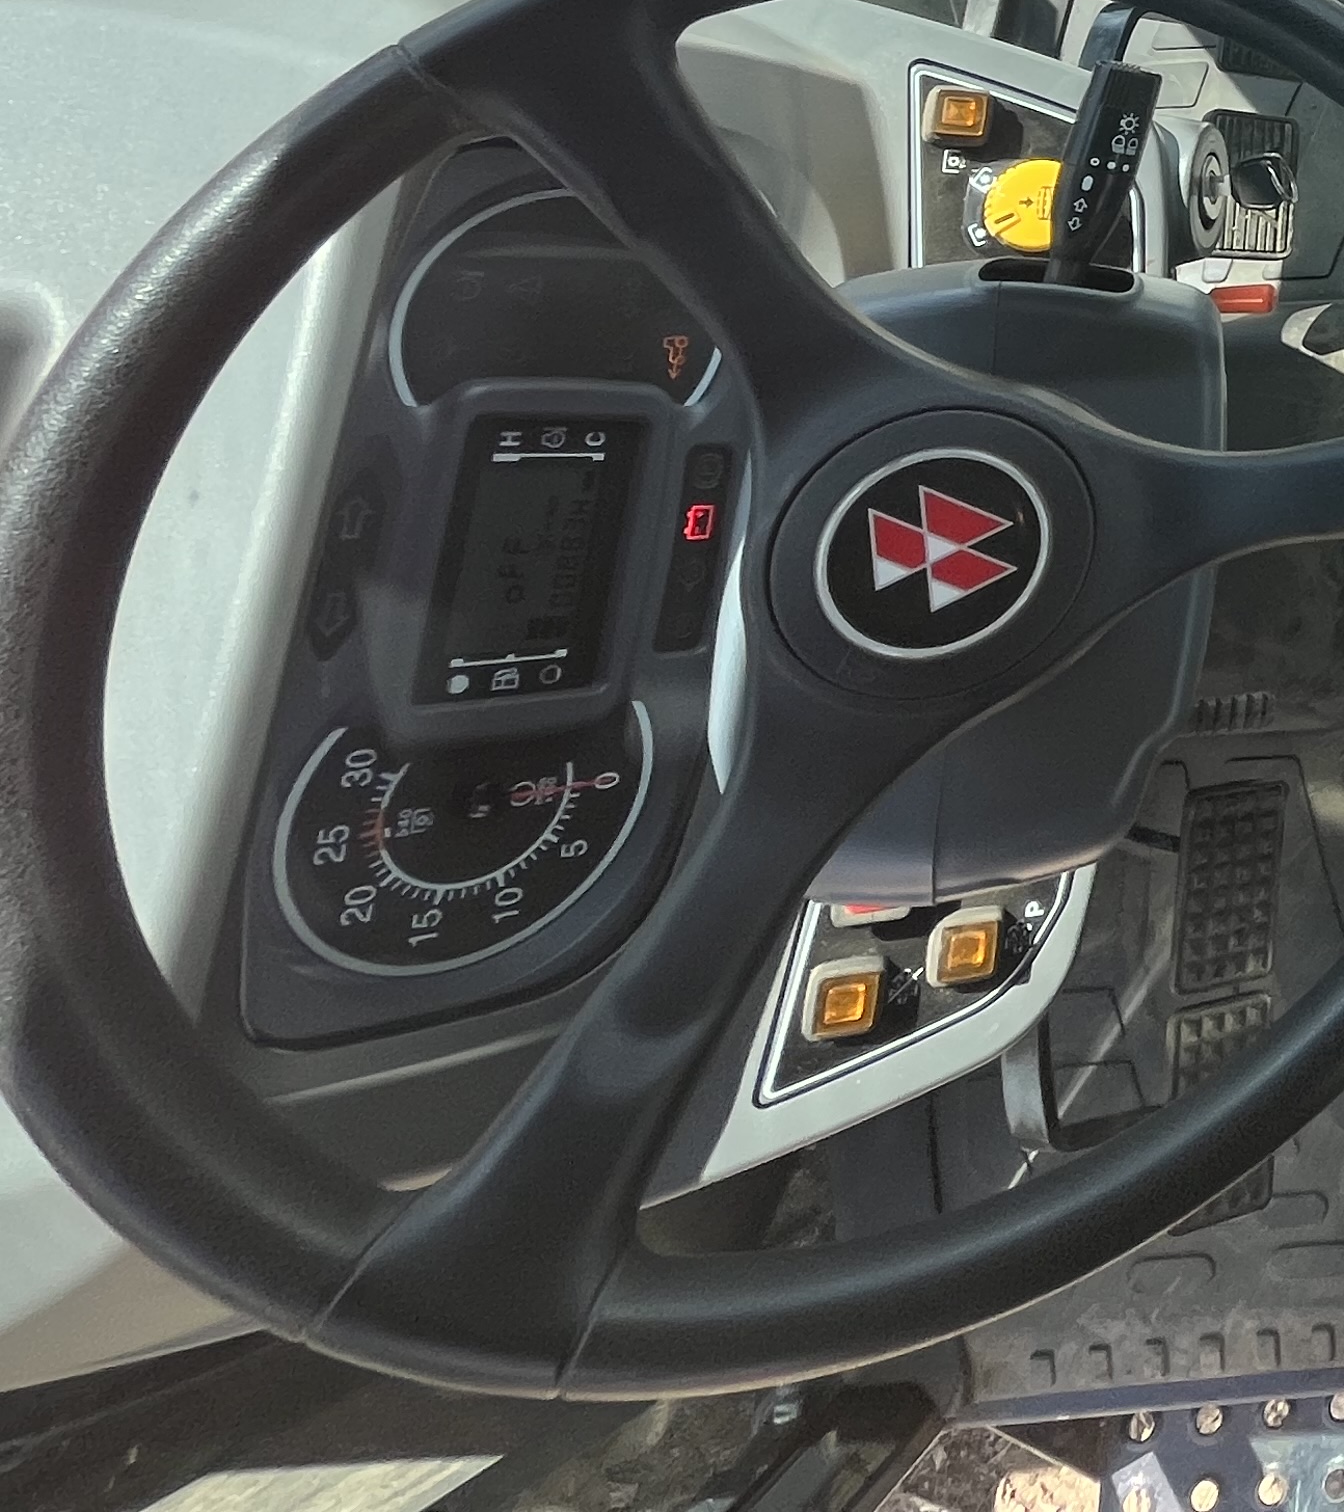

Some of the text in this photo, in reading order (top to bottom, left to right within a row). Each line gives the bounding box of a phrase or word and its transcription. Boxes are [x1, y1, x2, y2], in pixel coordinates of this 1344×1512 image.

[499, 431, 523, 447] H
[340, 748, 378, 789] 30
[594, 772, 620, 790] 0
[313, 824, 351, 867] 25
[560, 838, 589, 860] 5
[339, 885, 378, 927] 20
[491, 886, 524, 925] 10
[1024, 900, 1045, 918] P
[408, 907, 444, 948] 15
